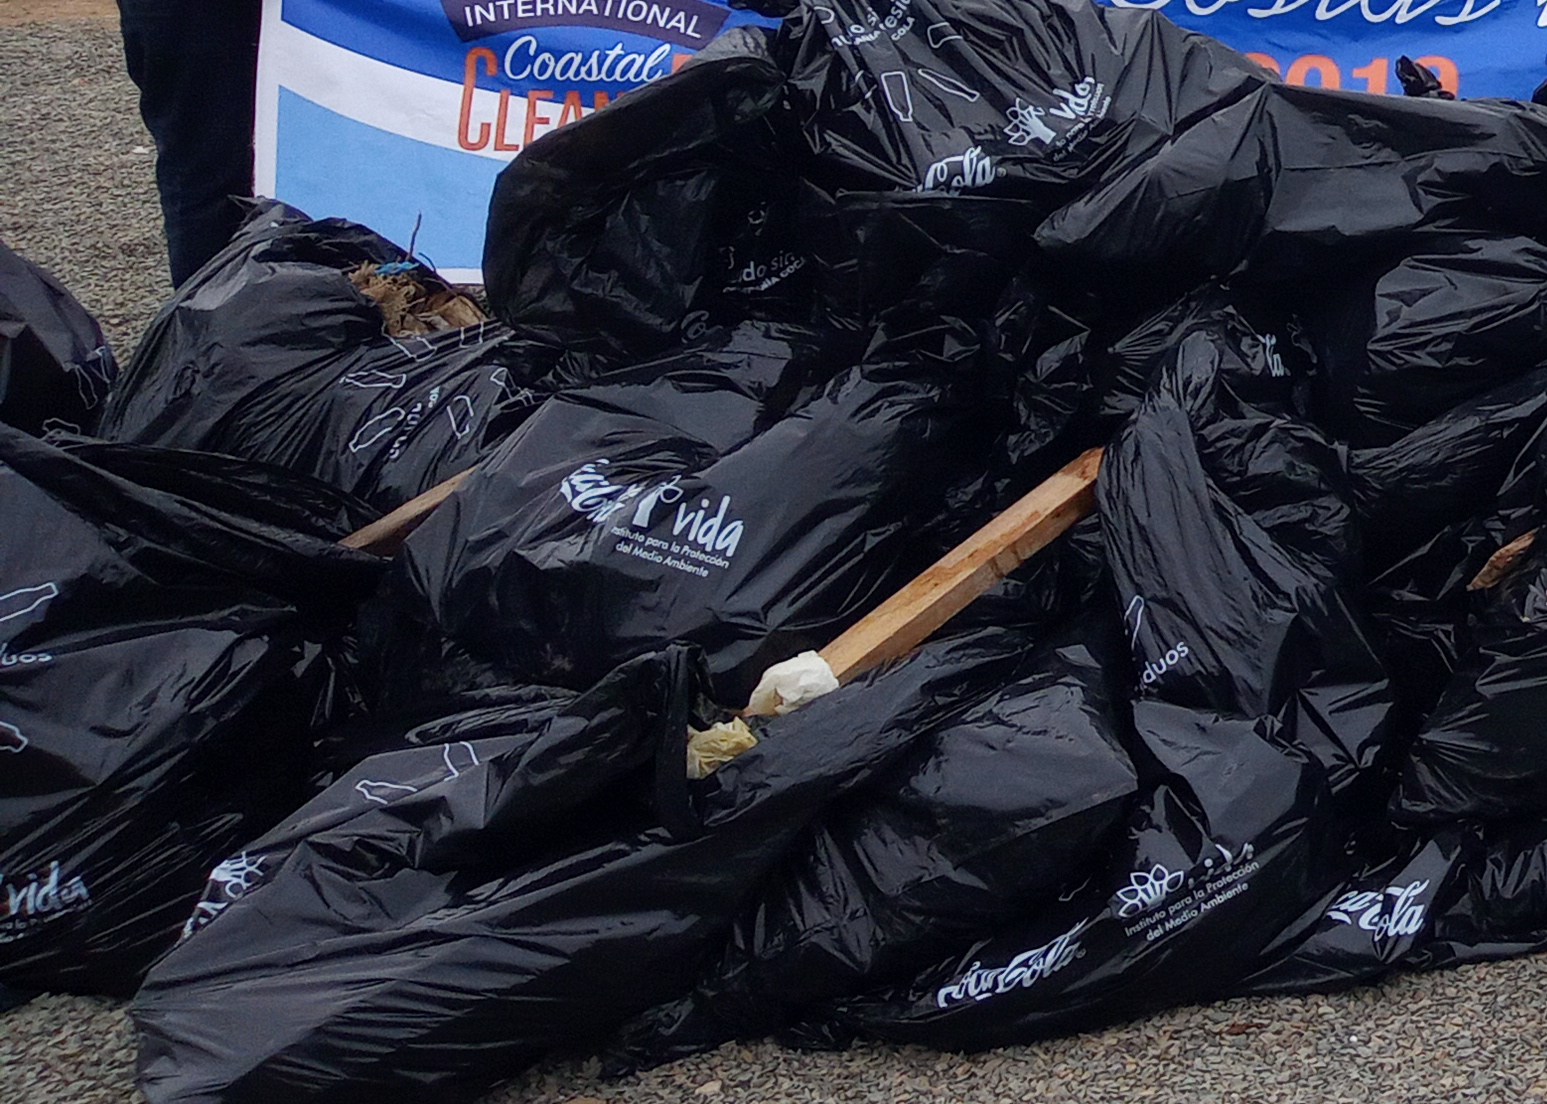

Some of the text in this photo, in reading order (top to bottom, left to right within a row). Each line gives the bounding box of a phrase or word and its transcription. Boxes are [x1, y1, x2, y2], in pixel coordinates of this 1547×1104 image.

[503, 36, 671, 85] Coastal
[610, 527, 730, 569] nstituto para la Protección
[672, 495, 743, 557] vida
[615, 541, 709, 577] del Medio Ambiente
[1142, 641, 1189, 684] duos
[1125, 909, 1168, 937] Instituto
[1167, 897, 1193, 914] para
[1193, 890, 1205, 902] la
[1206, 861, 1260, 895] Protección
[1145, 881, 1250, 942] del Medio Ambiente
